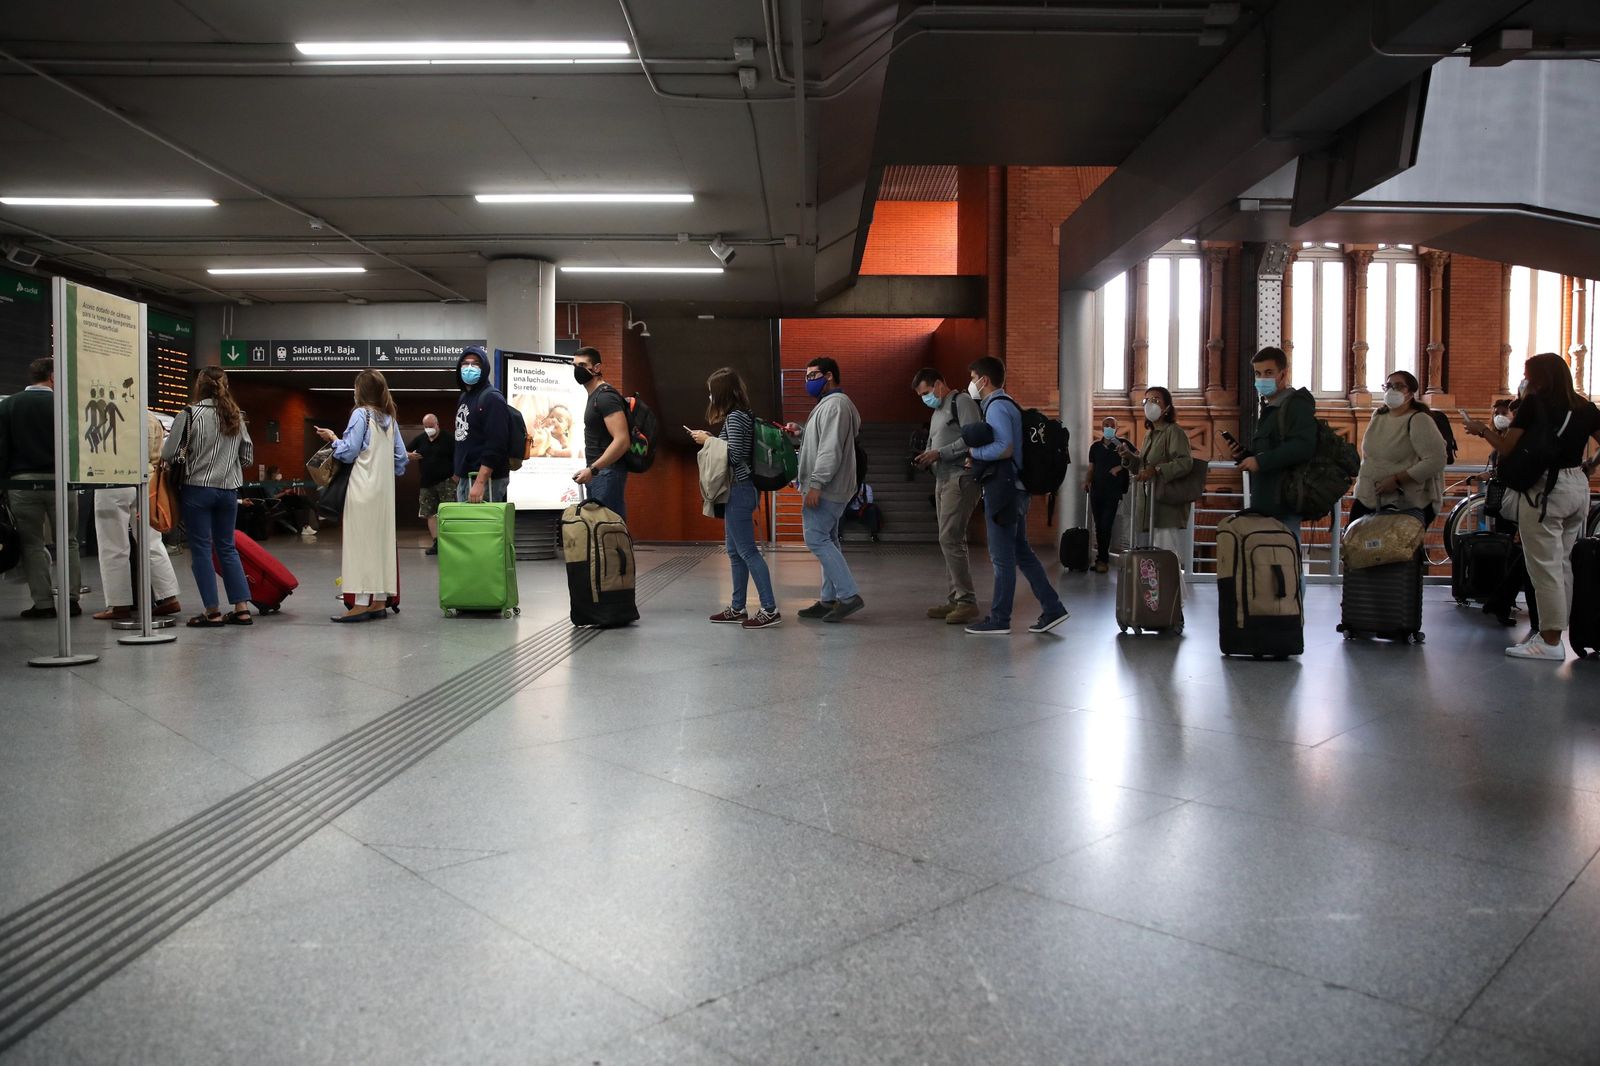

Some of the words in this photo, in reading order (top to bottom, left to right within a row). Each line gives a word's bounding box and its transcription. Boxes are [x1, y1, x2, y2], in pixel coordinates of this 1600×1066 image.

[293, 345, 322, 354] Salidas
[324, 345, 335, 354] Pl.
[337, 345, 355, 355] Baja
[394, 346, 418, 354] Venta
[420, 346, 431, 354] de
[433, 345, 464, 354] billetes
[513, 366, 523, 374] Ha
[523, 367, 546, 376] nacido
[513, 383, 523, 391] Su
